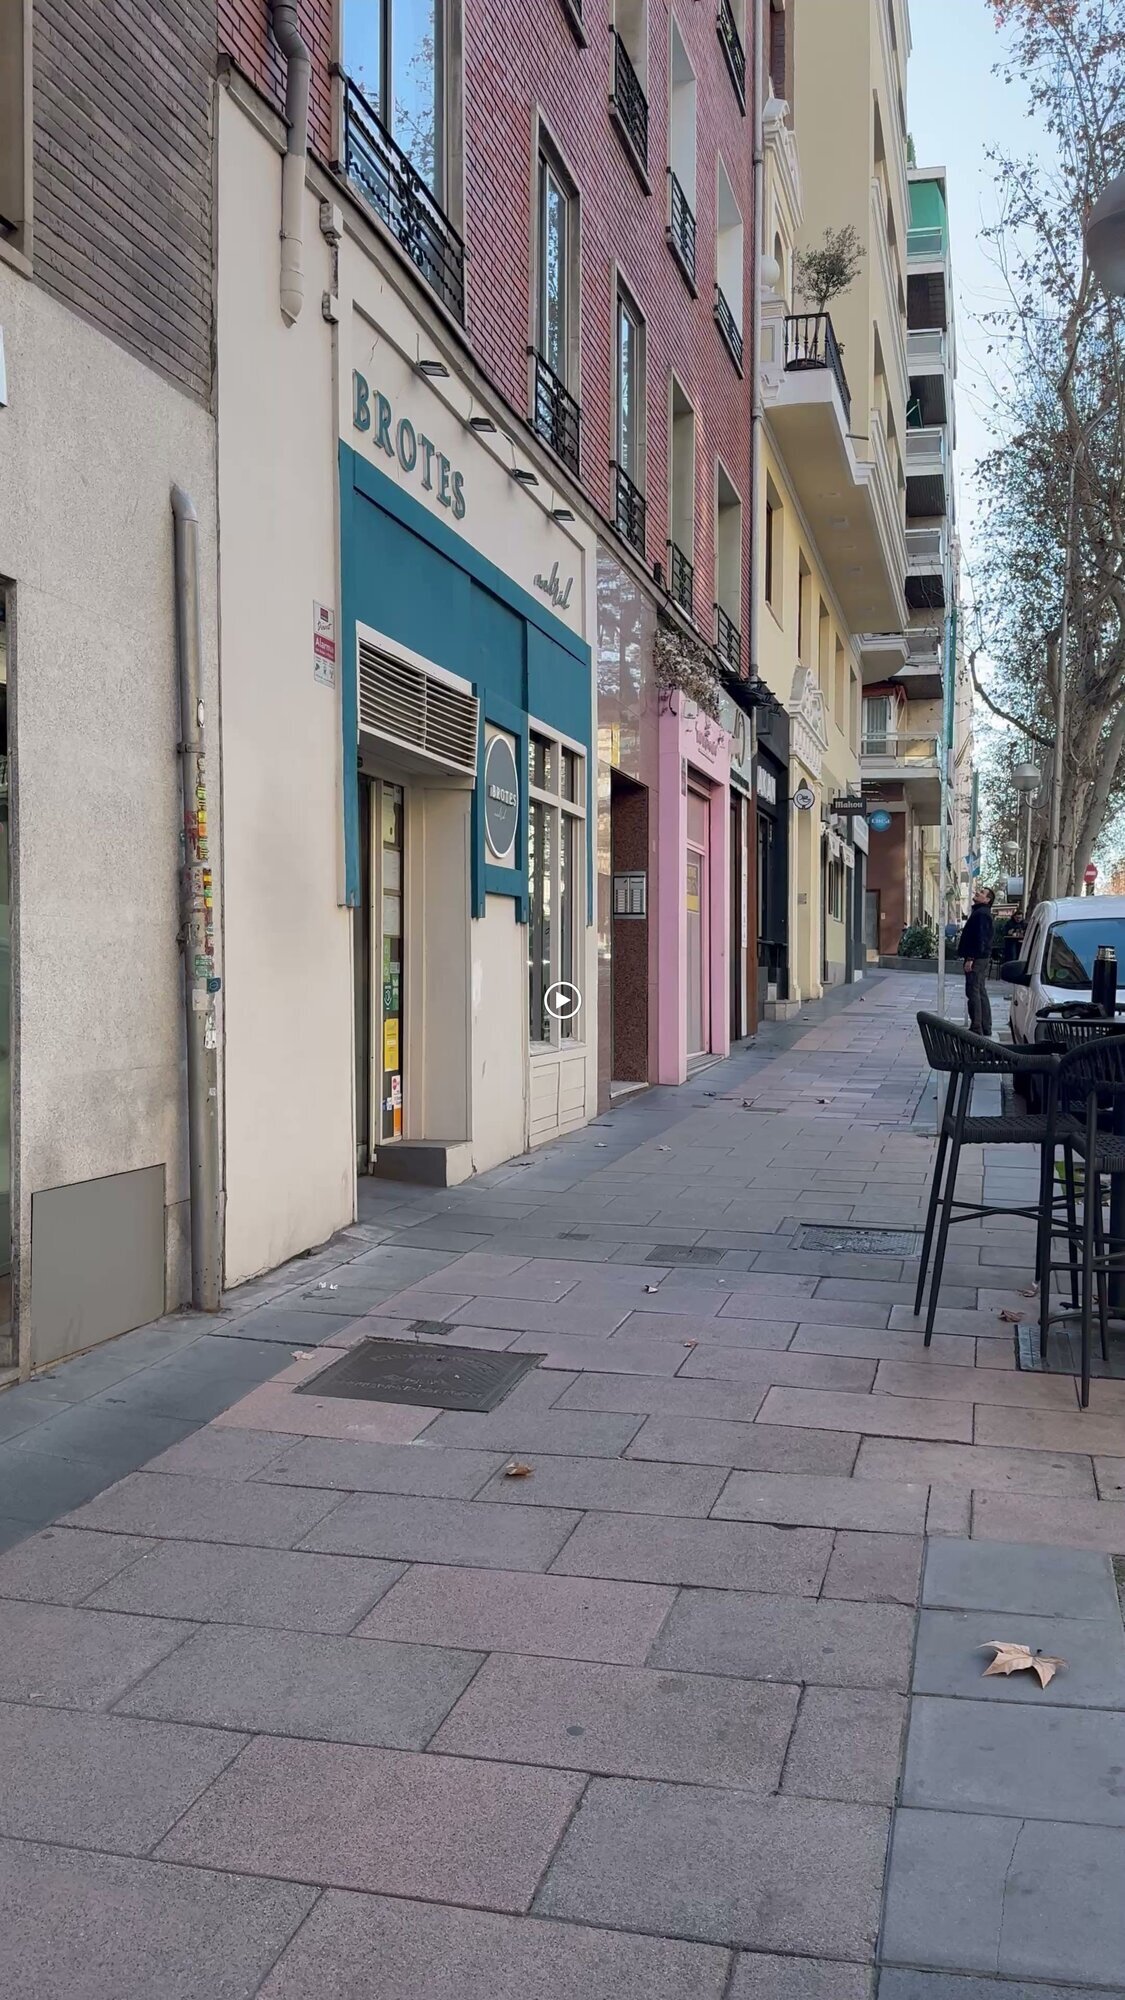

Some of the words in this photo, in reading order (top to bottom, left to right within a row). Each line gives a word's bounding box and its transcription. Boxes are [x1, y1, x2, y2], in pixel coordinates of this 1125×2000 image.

[352, 368, 466, 520] BROTES
[489, 784, 517, 807] BROTES
[835, 801, 863, 809] Mahou
